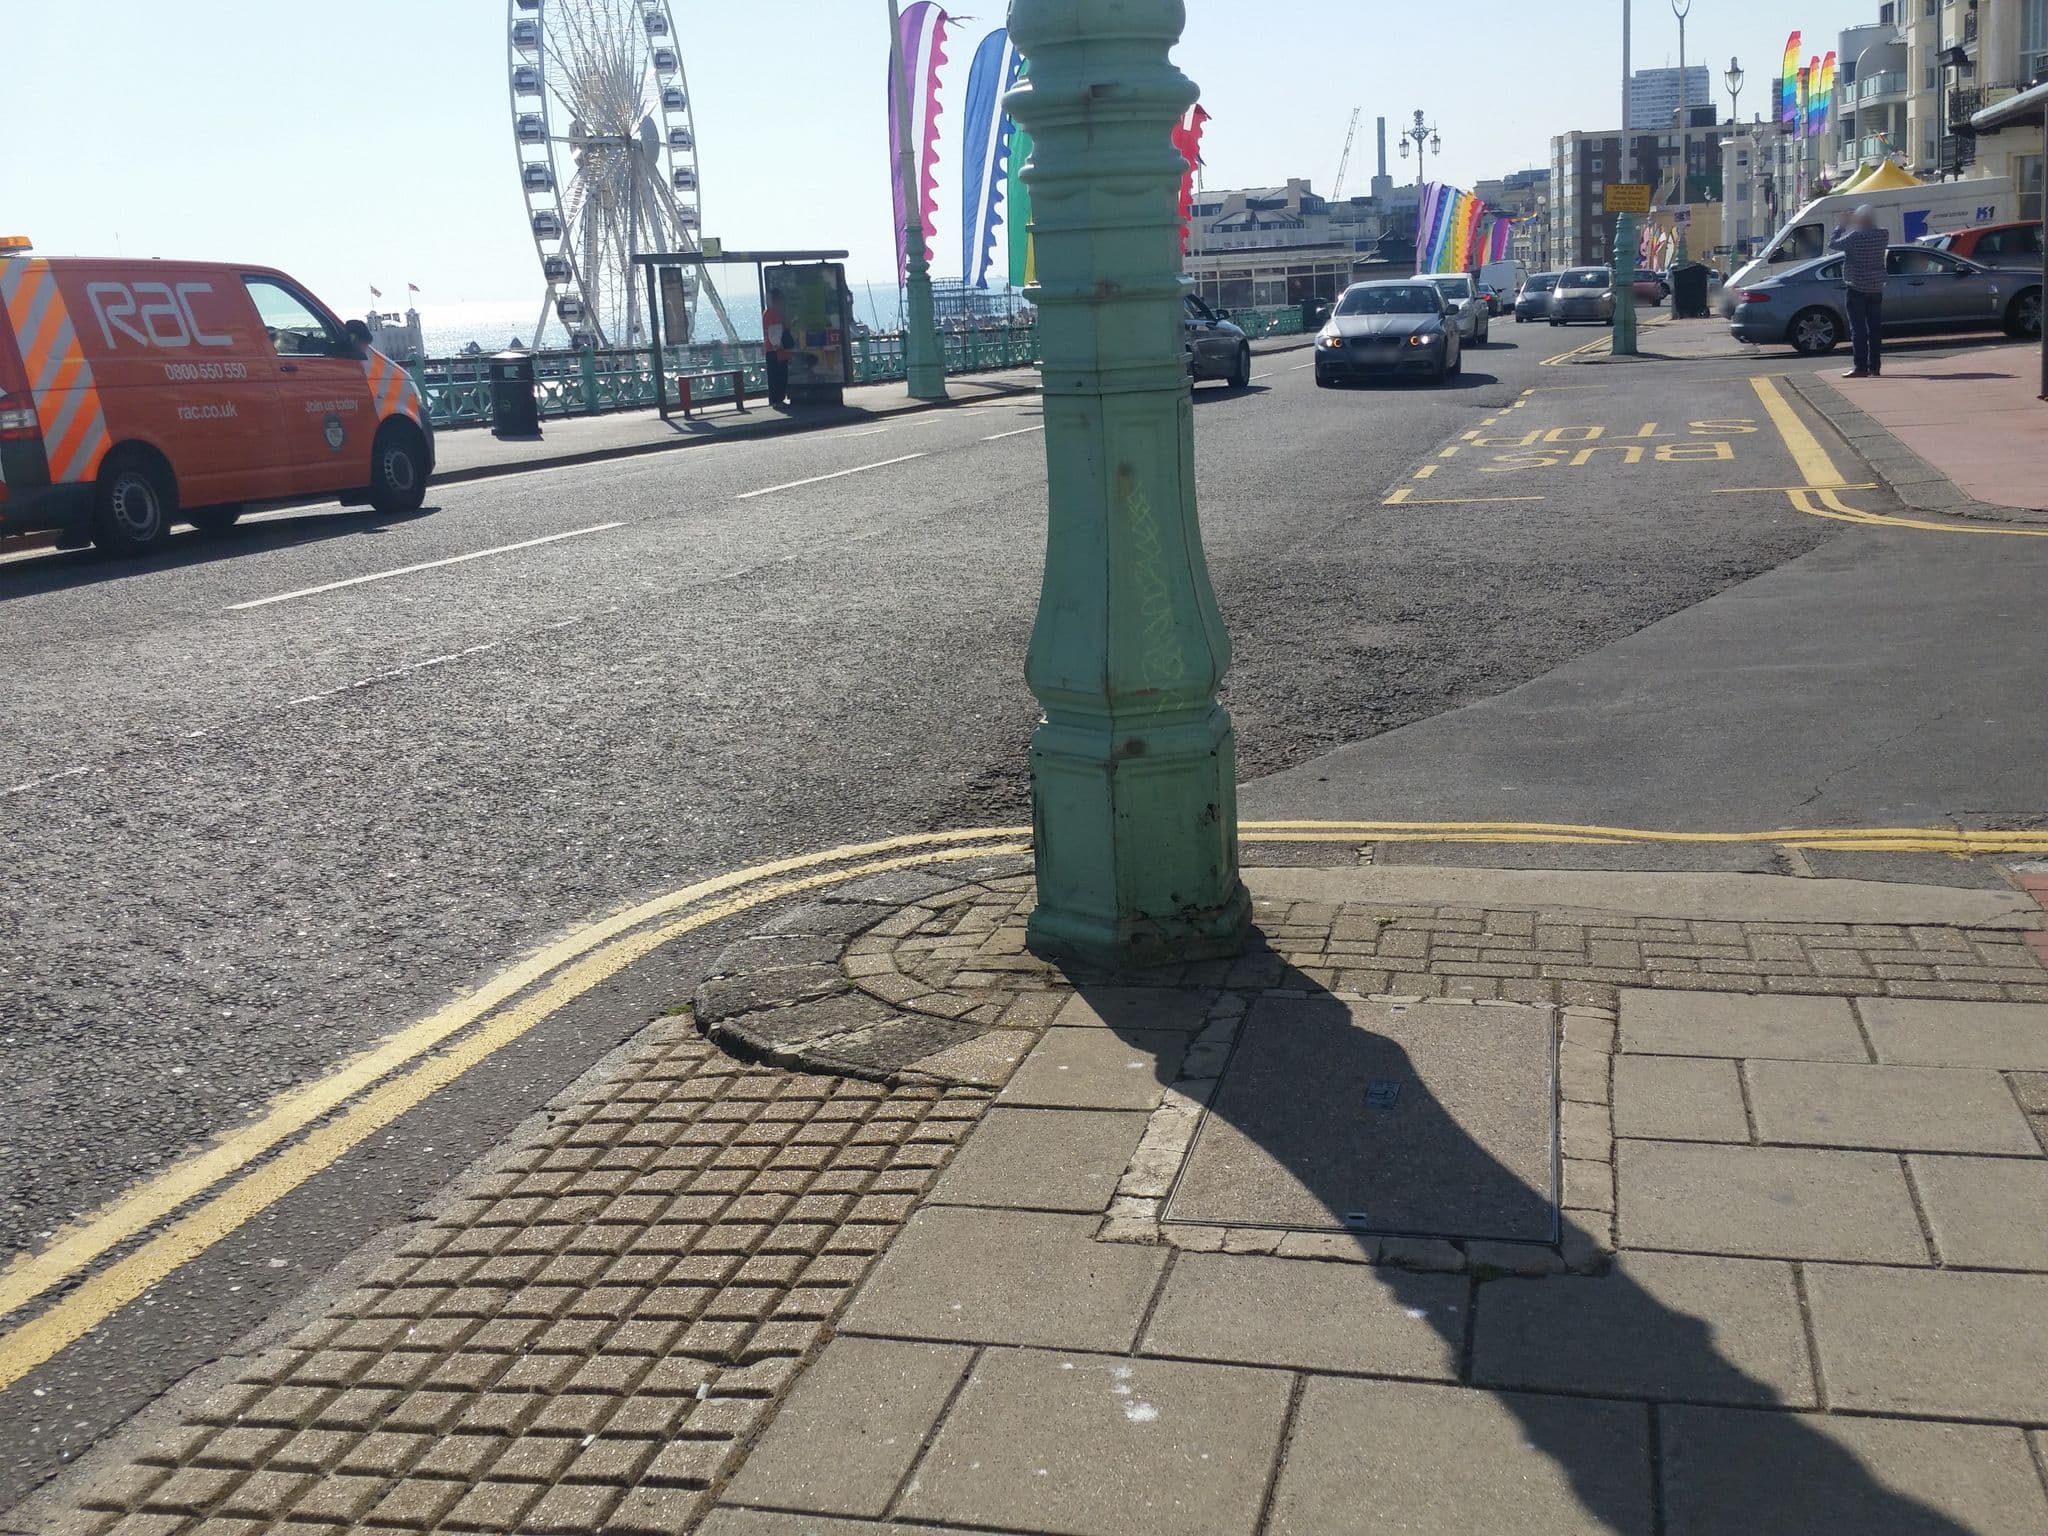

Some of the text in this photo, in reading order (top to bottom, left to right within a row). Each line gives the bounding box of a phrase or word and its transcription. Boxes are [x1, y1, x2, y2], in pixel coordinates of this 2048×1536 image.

[165, 362, 247, 380] 0800 550 550
[177, 401, 239, 420] rac.co.uk
[1471, 419, 1758, 447] STOP
[1477, 441, 1736, 472] BUS
